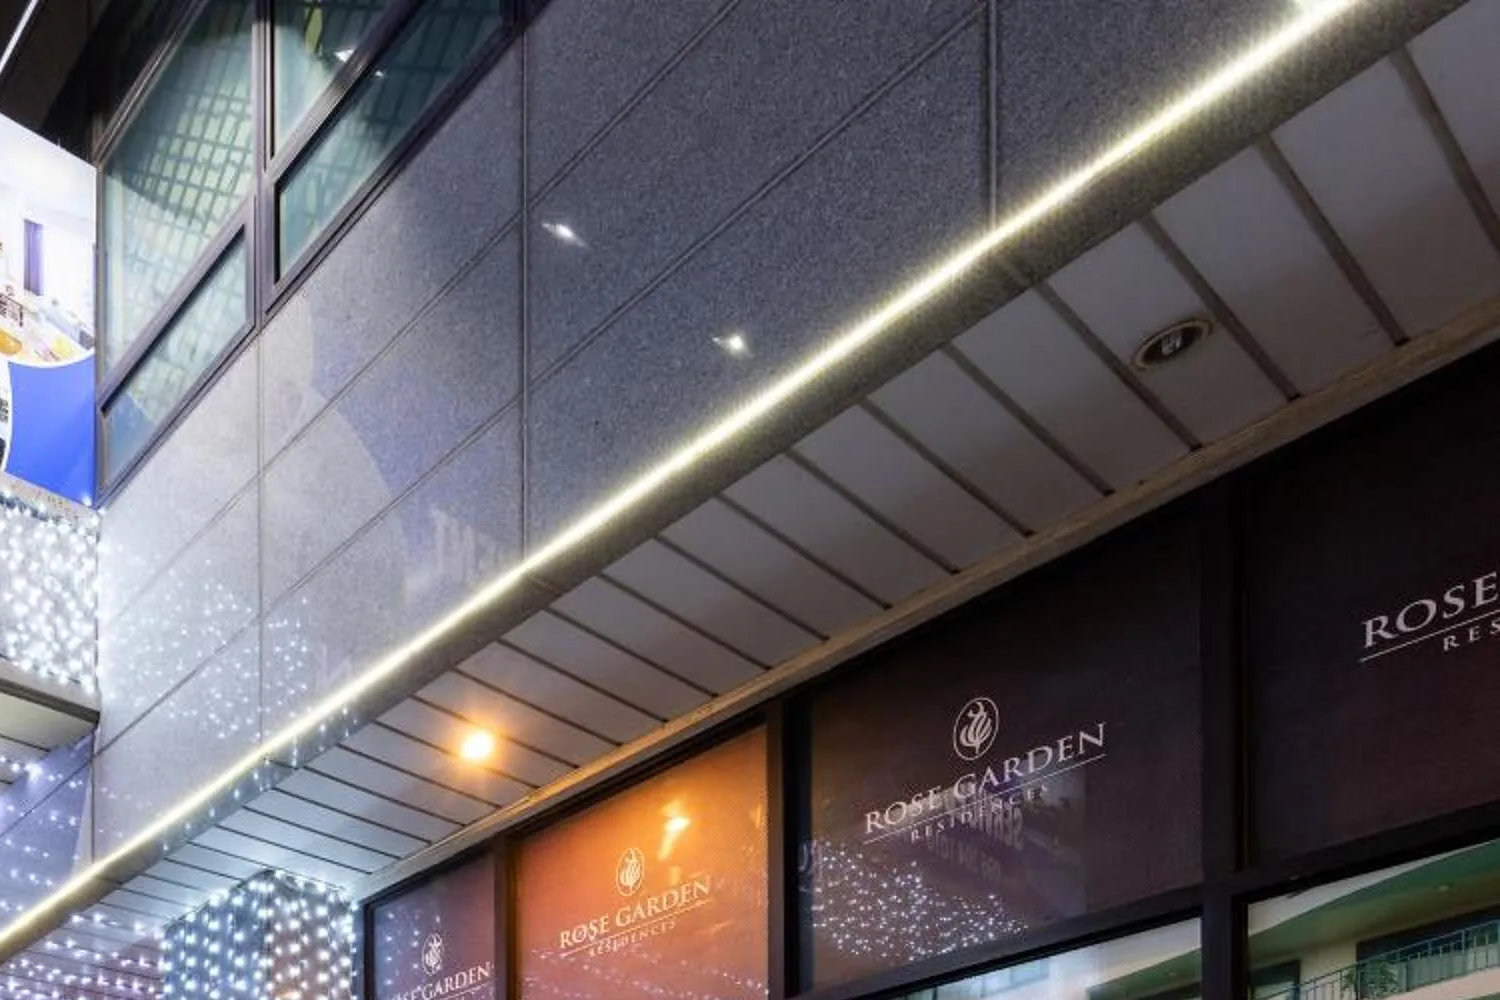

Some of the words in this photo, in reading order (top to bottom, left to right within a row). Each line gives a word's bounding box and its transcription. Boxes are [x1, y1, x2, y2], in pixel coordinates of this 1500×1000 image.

[1361, 571, 1499, 649] ROSE
[865, 785, 942, 835] ROSE
[953, 722, 1107, 800] GARDEN
[559, 914, 611, 949] ROSE
[615, 874, 711, 928] GARDEN
[421, 961, 491, 1000] GARDEN
